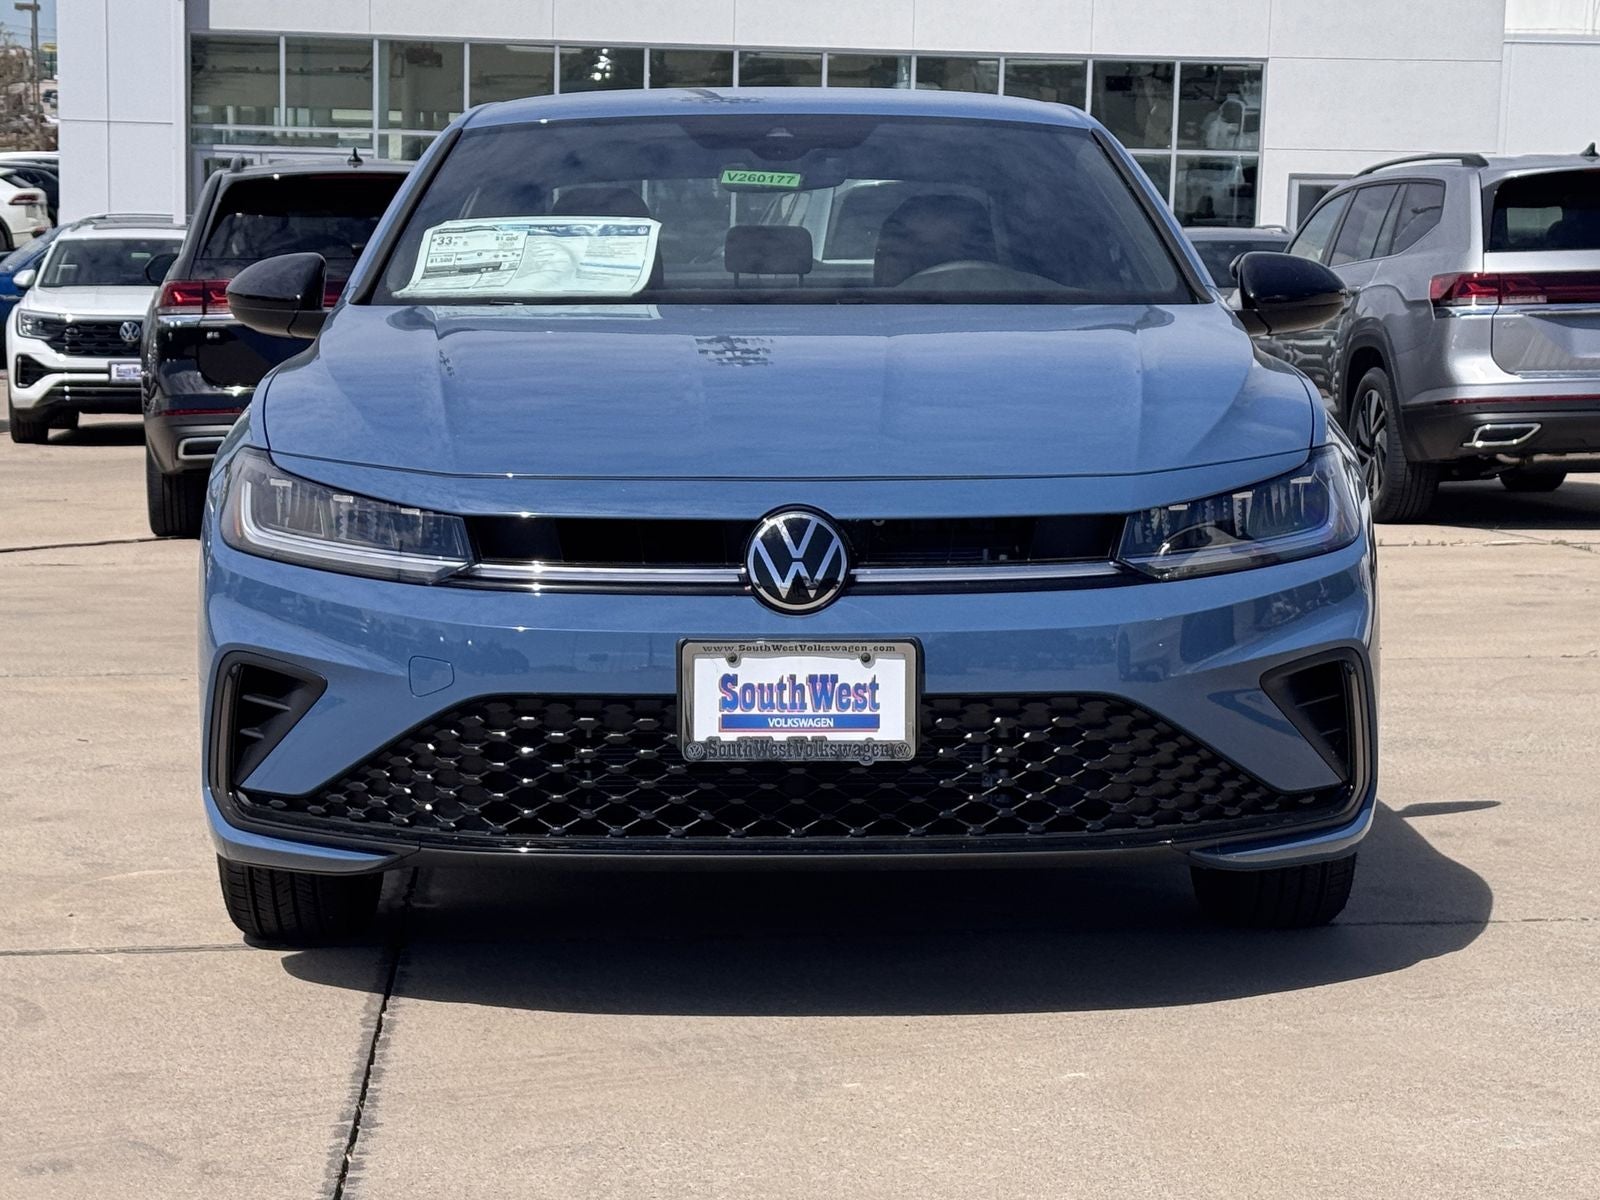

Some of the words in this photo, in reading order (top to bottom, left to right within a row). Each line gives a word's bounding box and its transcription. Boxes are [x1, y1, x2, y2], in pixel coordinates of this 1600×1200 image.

[727, 173, 795, 184] V260177
[751, 514, 844, 606] VW
[702, 644, 896, 653] www.SouthWestVolkswagen.com
[767, 717, 835, 728] VOLKSWAGEN
